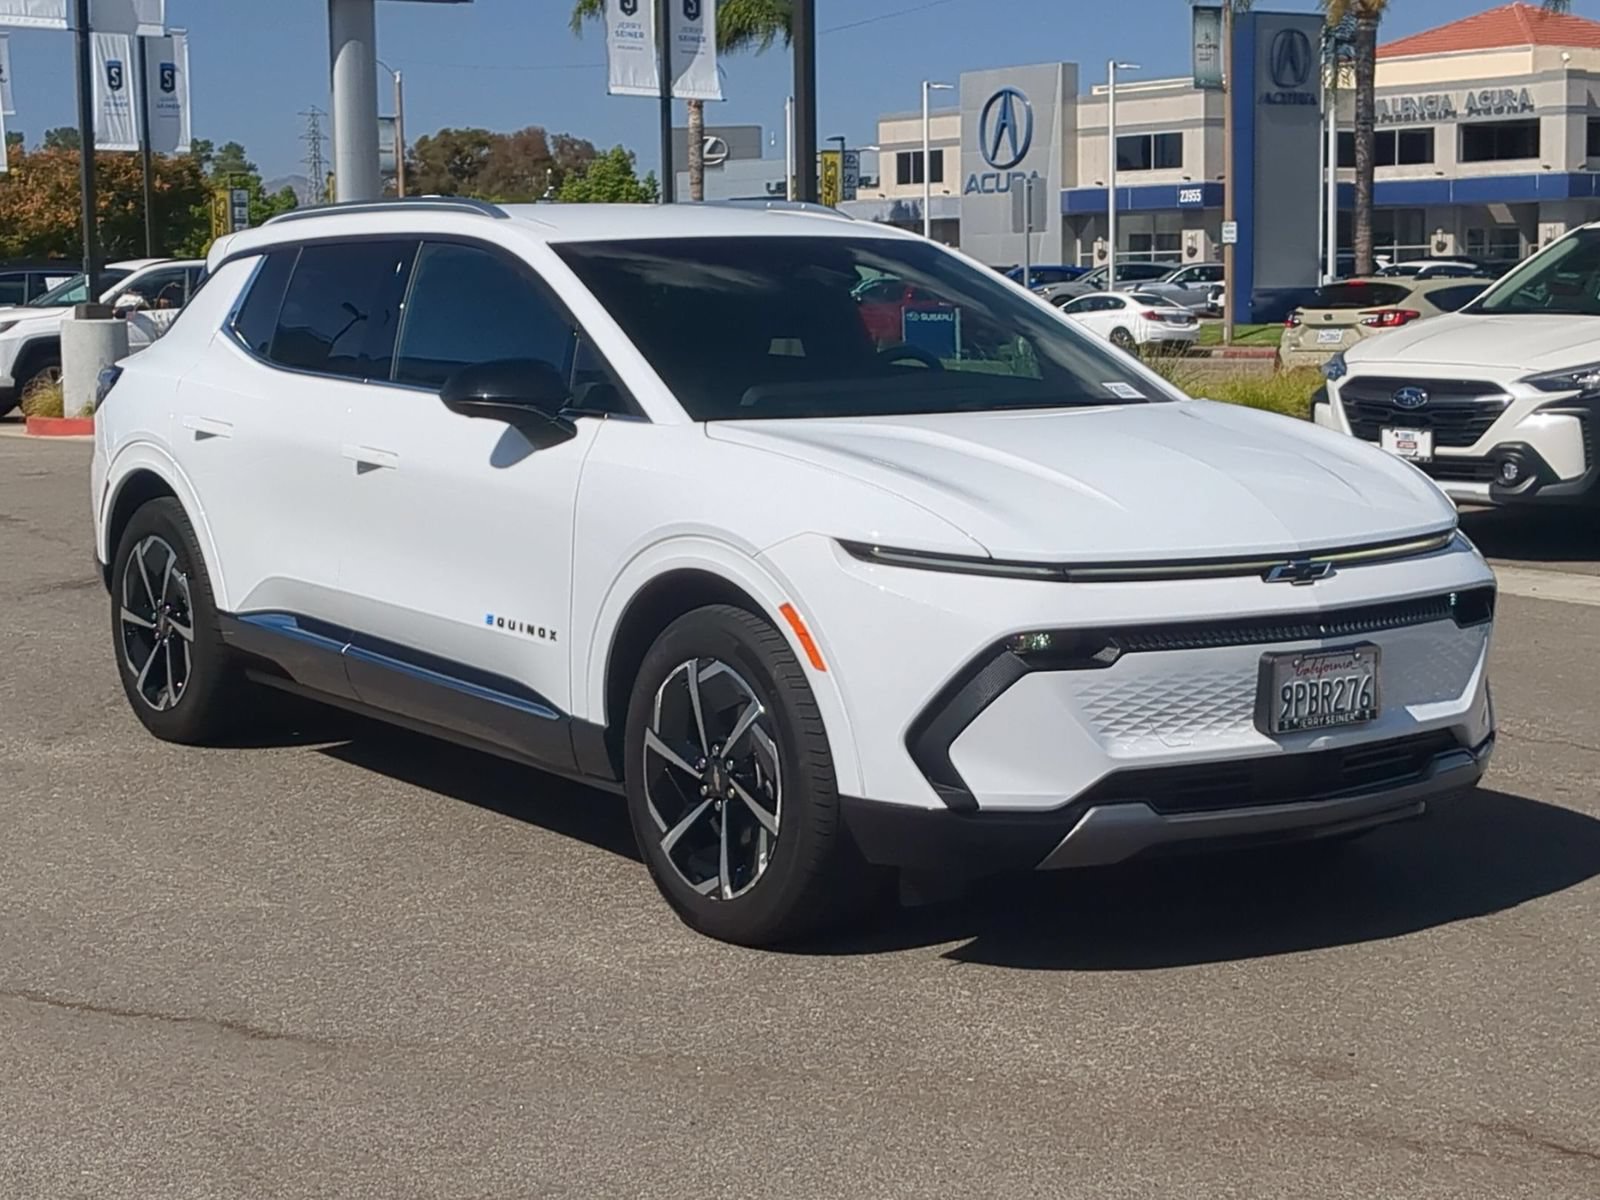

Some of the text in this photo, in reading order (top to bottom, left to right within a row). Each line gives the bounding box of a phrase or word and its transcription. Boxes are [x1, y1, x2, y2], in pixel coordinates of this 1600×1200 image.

[615, 30, 645, 39] SEINER
[1375, 87, 1531, 117] ALENCIA ACURA
[485, 613, 558, 642] EQUINOX
[1295, 658, 1358, 679] California
[1281, 675, 1372, 719] 9PBR276
[1325, 712, 1356, 725] SEINER
